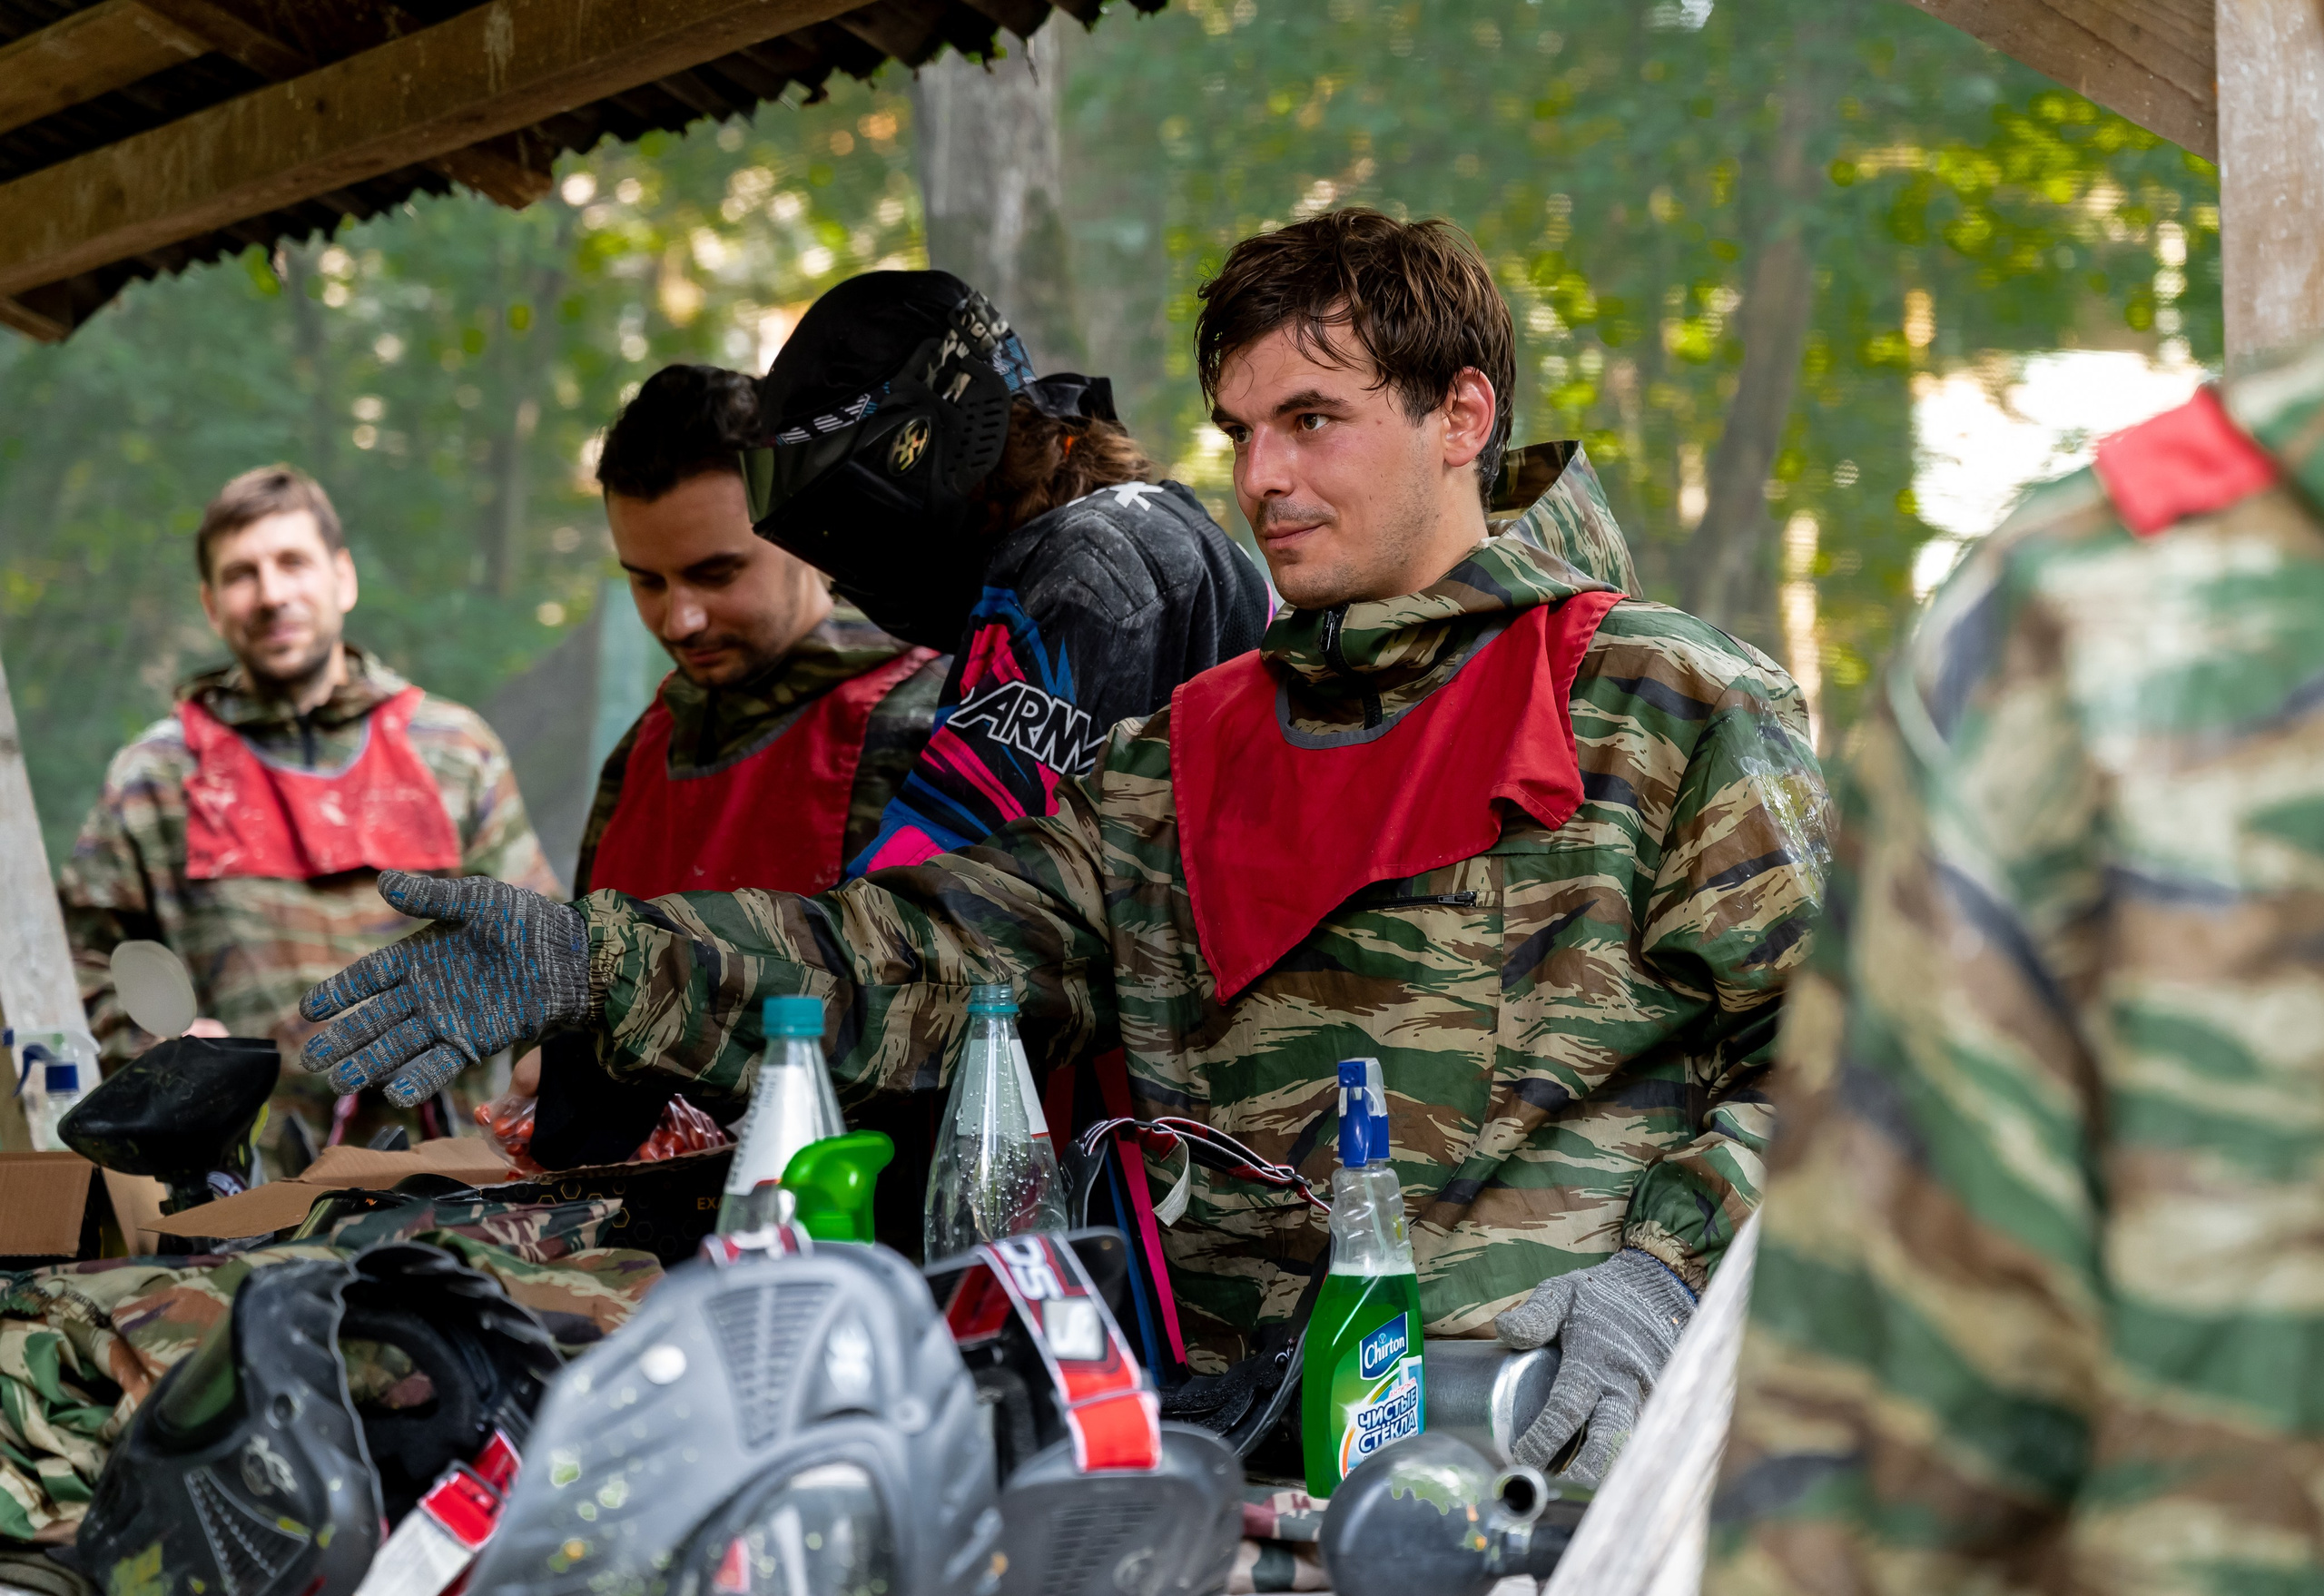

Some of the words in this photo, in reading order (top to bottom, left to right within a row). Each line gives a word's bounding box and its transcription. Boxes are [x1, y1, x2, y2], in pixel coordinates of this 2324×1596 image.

[1364, 1337, 1405, 1369] Chirton
[1358, 1386, 1417, 1431] ЧИСТЫЕ
[1359, 1410, 1417, 1453] СТЁКЛА
